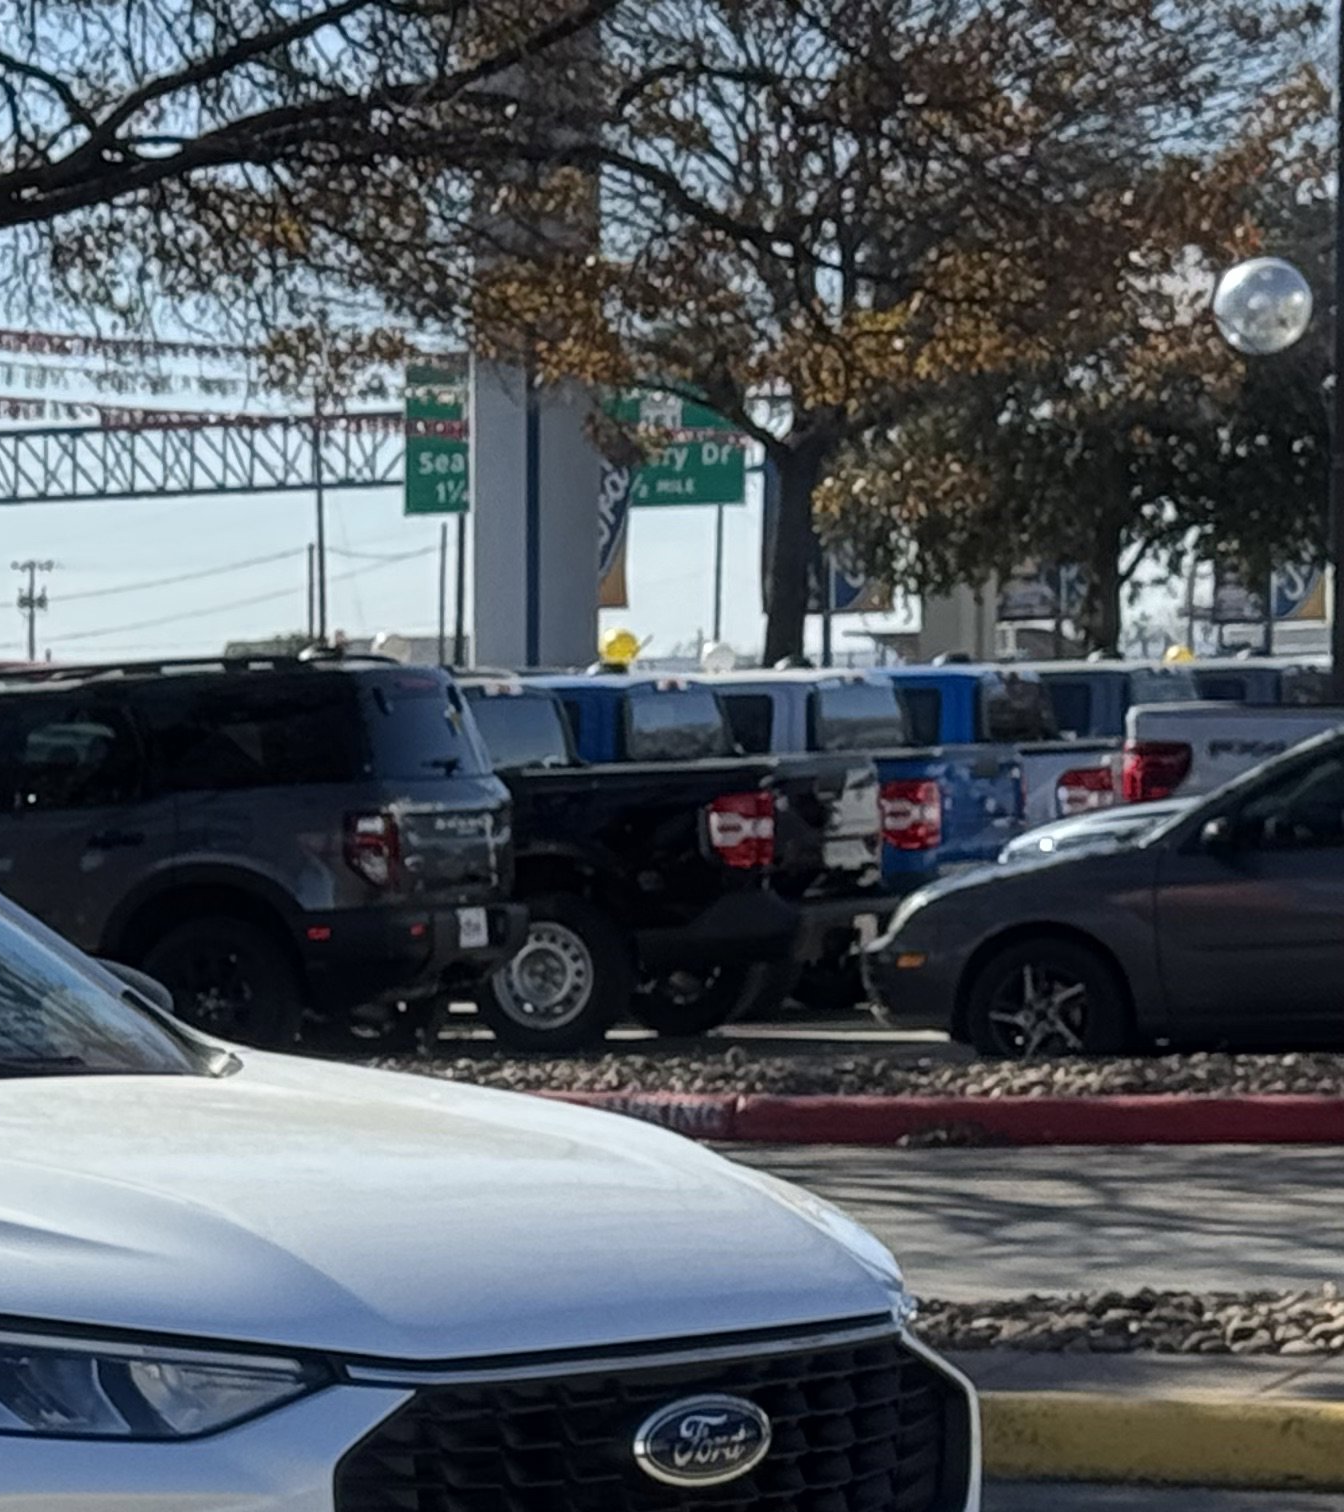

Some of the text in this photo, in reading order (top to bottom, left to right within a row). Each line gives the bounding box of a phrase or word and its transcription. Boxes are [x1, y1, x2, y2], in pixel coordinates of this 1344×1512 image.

[417, 450, 466, 476] Sea
[701, 441, 733, 466] Dr
[674, 1413, 747, 1466] Ford
